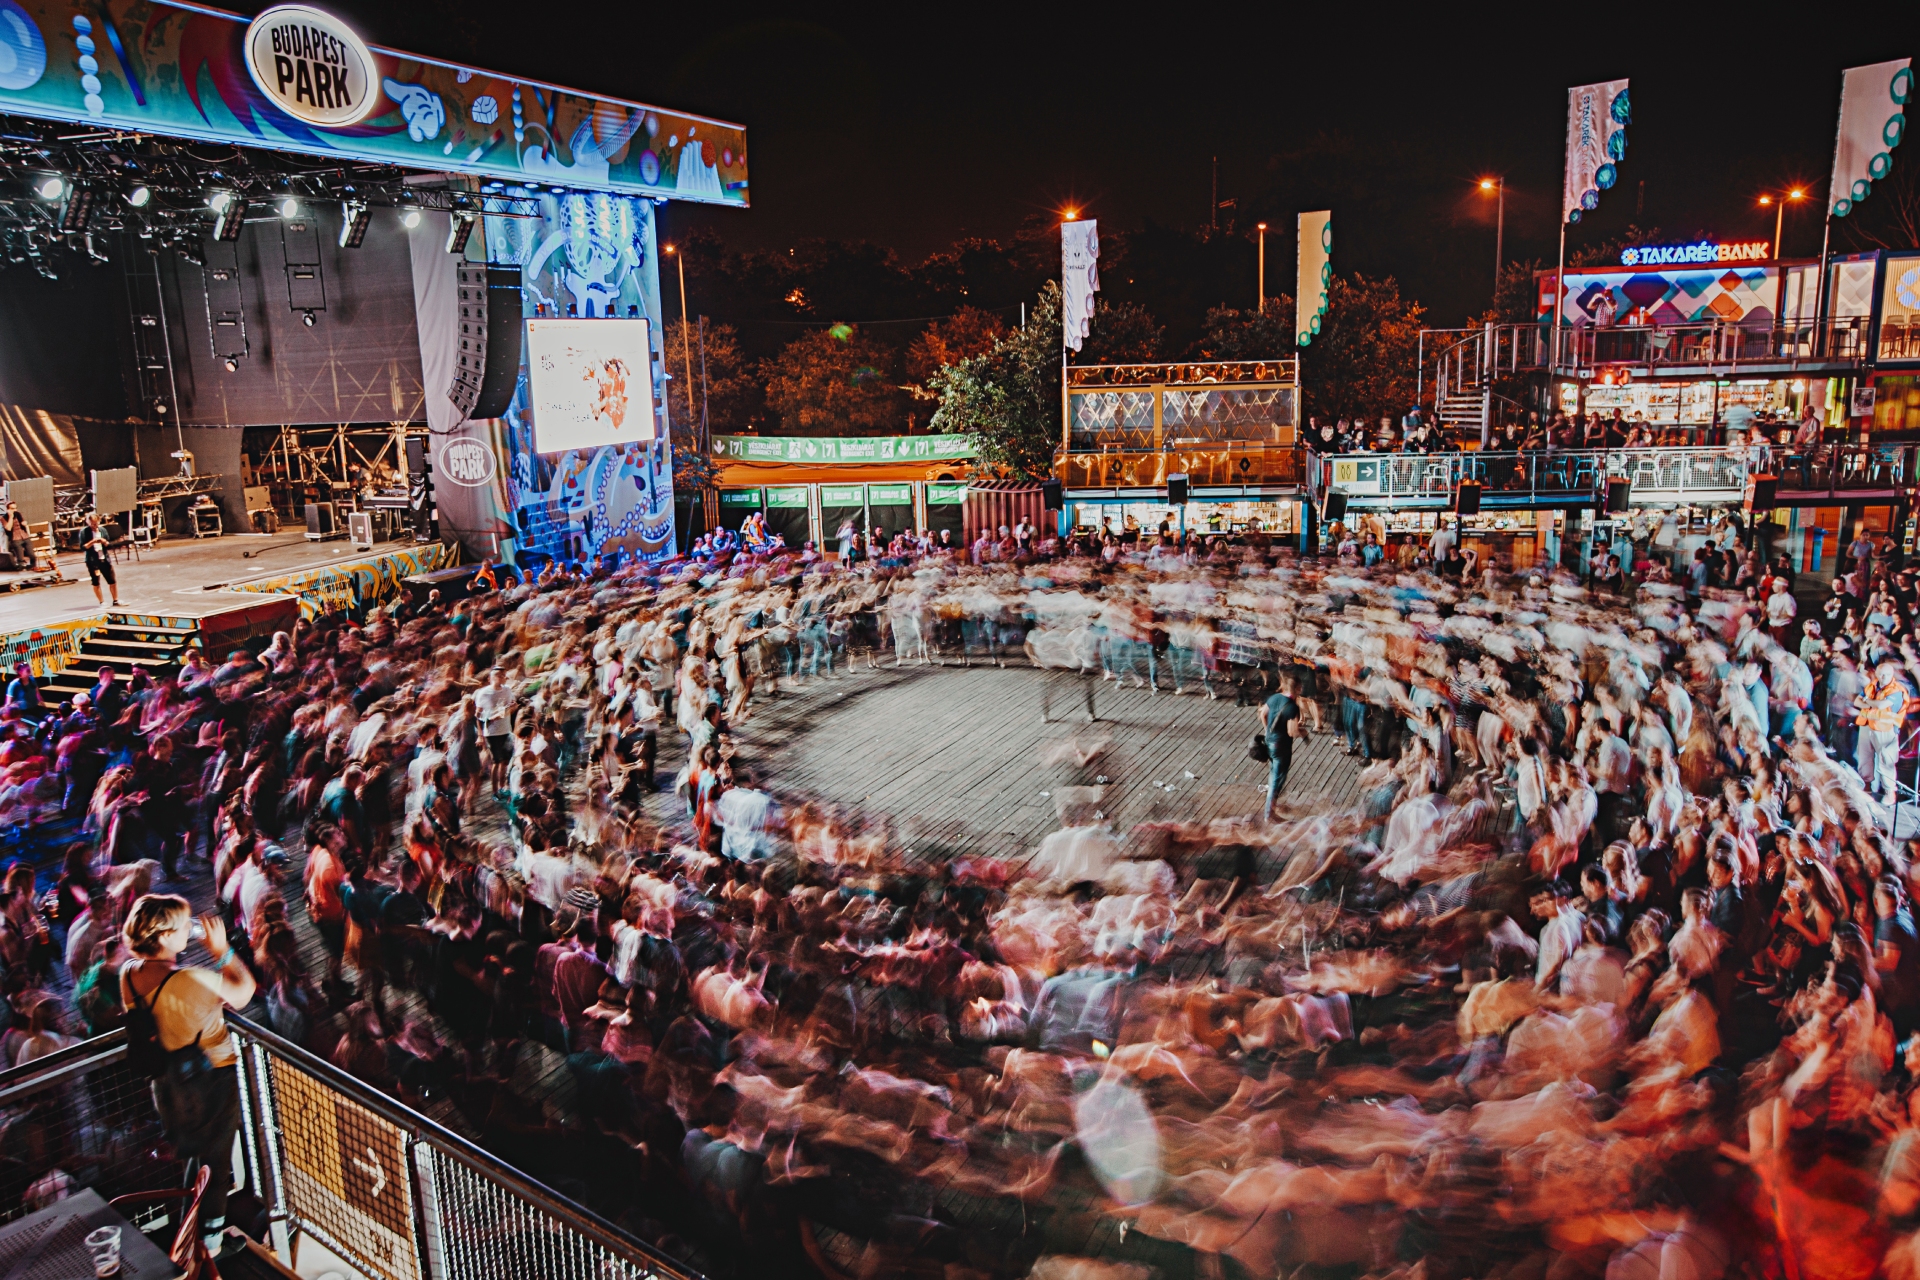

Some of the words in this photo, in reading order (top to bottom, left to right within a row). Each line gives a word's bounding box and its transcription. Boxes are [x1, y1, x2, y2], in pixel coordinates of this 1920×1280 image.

[271, 24, 347, 67] BUDAPEST
[275, 54, 352, 109] PARK
[1640, 241, 1769, 264] TAKARÉKBANK
[449, 444, 485, 459] BUDAPEST
[450, 459, 487, 480] PARK
